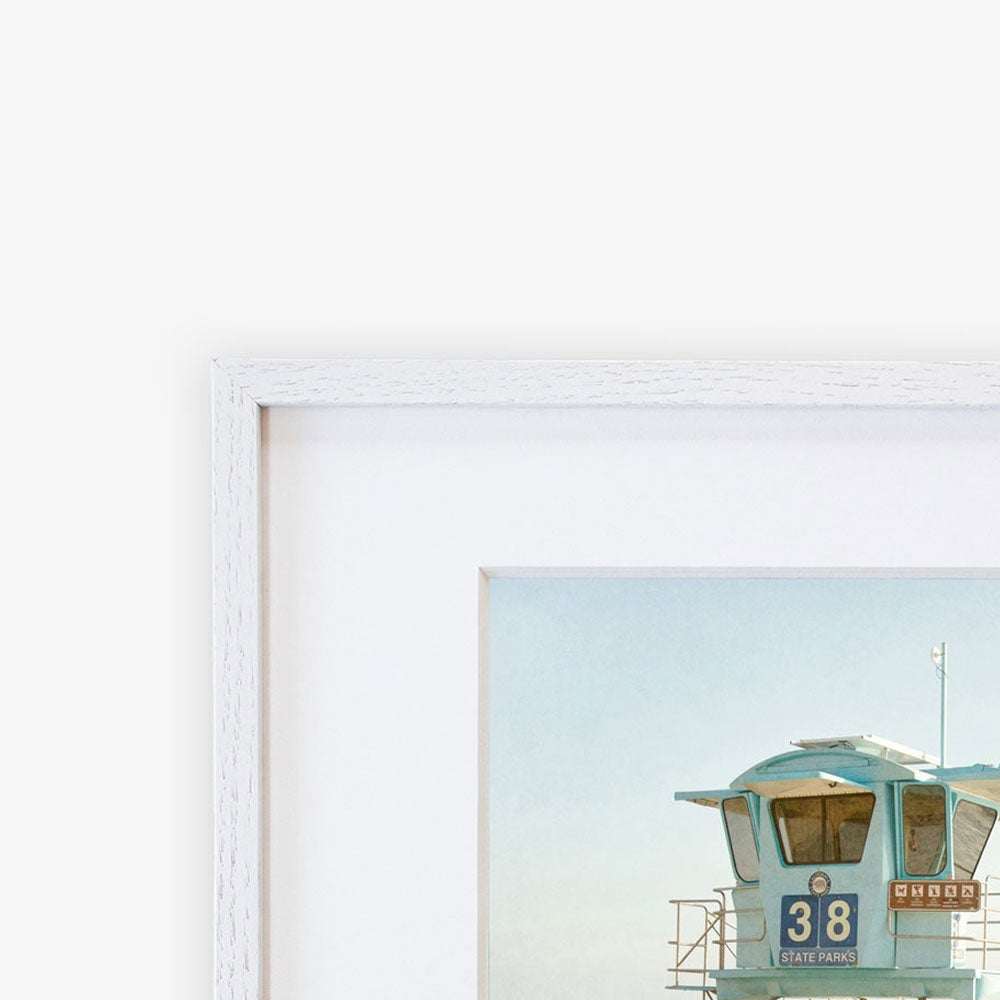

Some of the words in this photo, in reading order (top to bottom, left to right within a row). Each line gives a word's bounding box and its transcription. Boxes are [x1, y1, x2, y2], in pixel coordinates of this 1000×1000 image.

[788, 900, 851, 942] 38
[782, 952, 816, 963] STATE
[818, 952, 856, 963] PARKS
